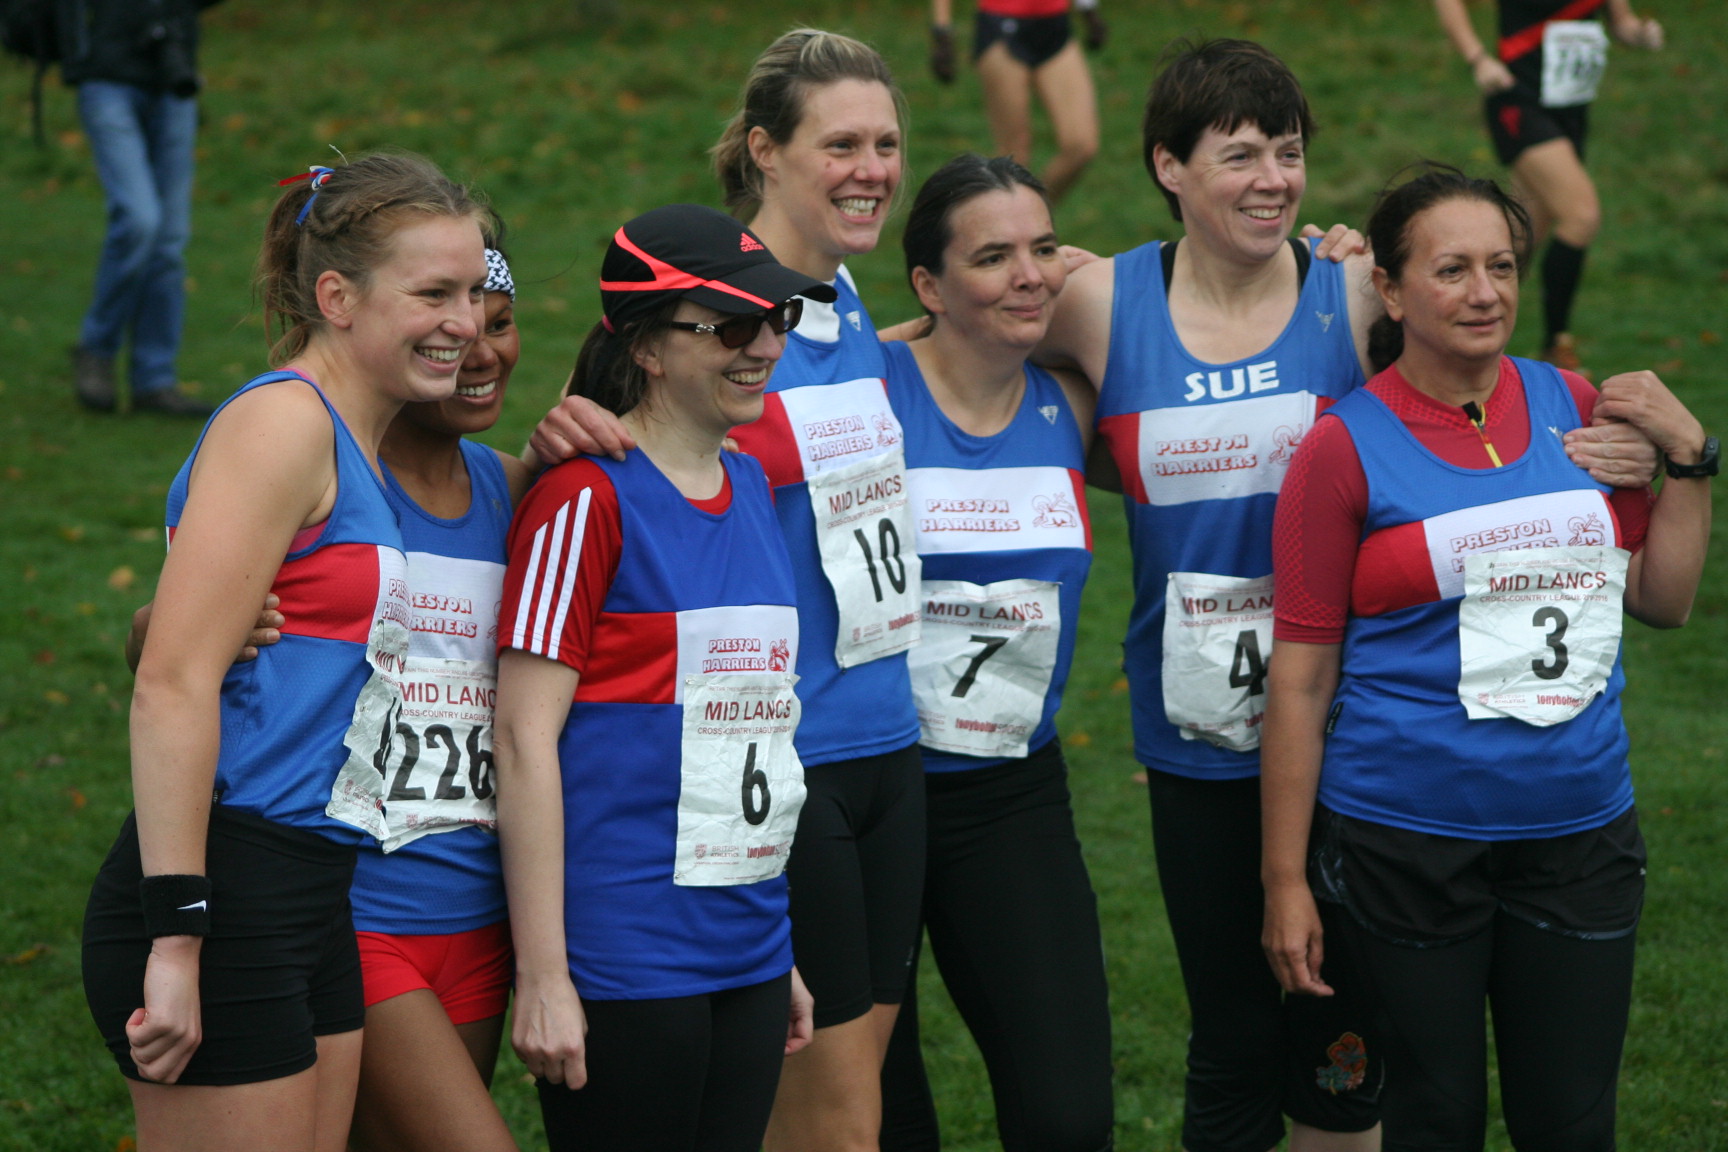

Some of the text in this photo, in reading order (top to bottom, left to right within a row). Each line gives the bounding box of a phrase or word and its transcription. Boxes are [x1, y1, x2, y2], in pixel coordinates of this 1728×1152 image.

[1183, 360, 1280, 402] SUE
[804, 414, 865, 440] PRESTON
[808, 434, 874, 462] HARRIERS
[1156, 433, 1248, 456] PRESTON
[1151, 454, 1257, 476] HARRIERS
[829, 491, 853, 515] MID
[856, 474, 902, 506] LANCS
[926, 499, 1009, 513] PRESTON
[920, 518, 1020, 532] HARRIERS
[1450, 518, 1552, 553] PRESTON
[853, 517, 906, 603] 10
[1489, 571, 1607, 593] MID LANCS
[411, 592, 472, 614] ESTON
[926, 601, 1044, 622] MID LANCS
[1182, 596, 1218, 615] MID
[411, 615, 478, 638] RRIERS
[708, 638, 761, 654] PRESTON
[1531, 606, 1569, 680] 3
[703, 657, 766, 674] HARRIERS
[951, 635, 1009, 698] 7
[1229, 628, 1271, 697] 4
[400, 681, 440, 703] MID
[704, 699, 792, 721] MID LANCS
[387, 722, 495, 801] 226
[741, 742, 771, 826] 6
